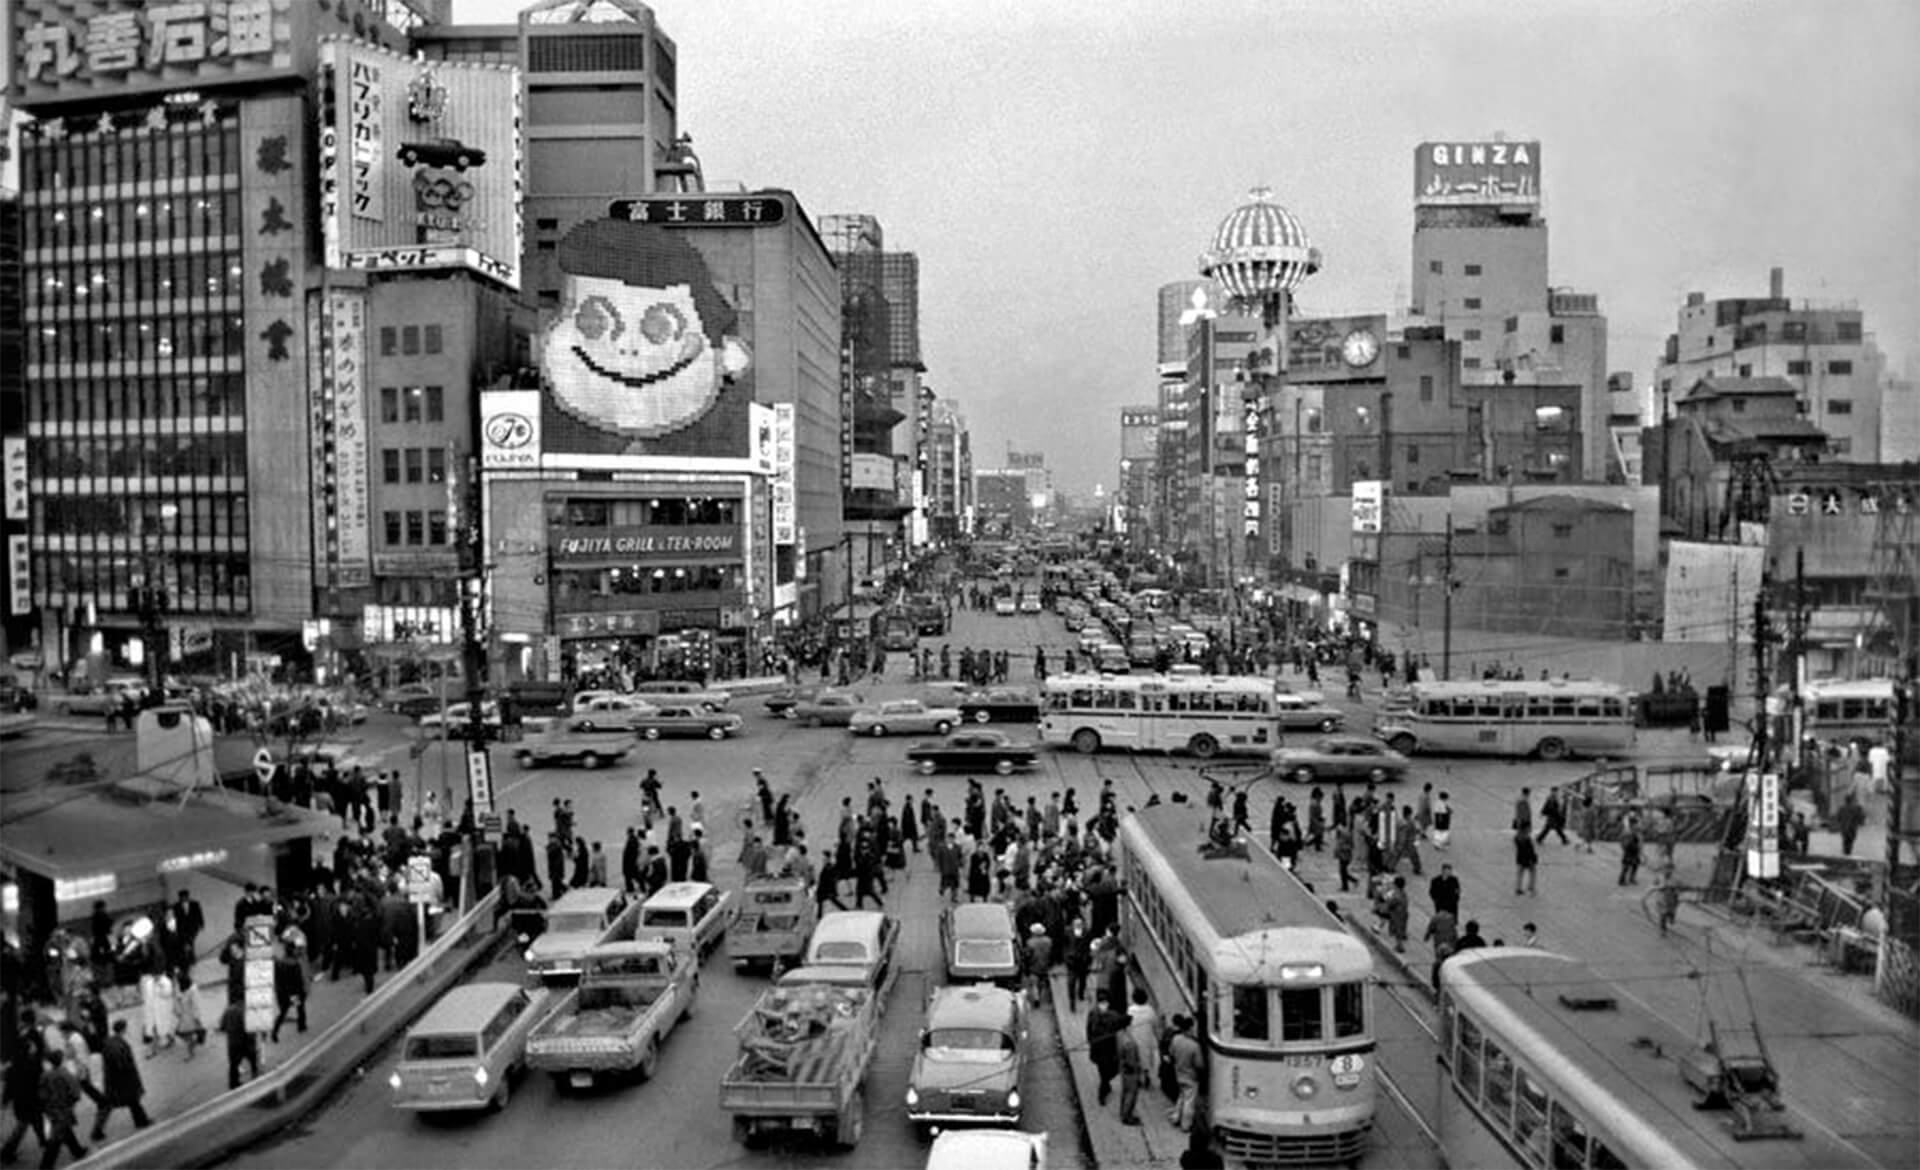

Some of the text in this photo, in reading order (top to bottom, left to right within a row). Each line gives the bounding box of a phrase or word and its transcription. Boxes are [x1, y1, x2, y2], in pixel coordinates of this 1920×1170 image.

[24, 1, 273, 79] 丸善石油
[1433, 145, 1529, 165] GINZA
[628, 201, 763, 222] 富士銀行
[559, 538, 611, 552] FUJIYA
[615, 537, 655, 551] GRILL
